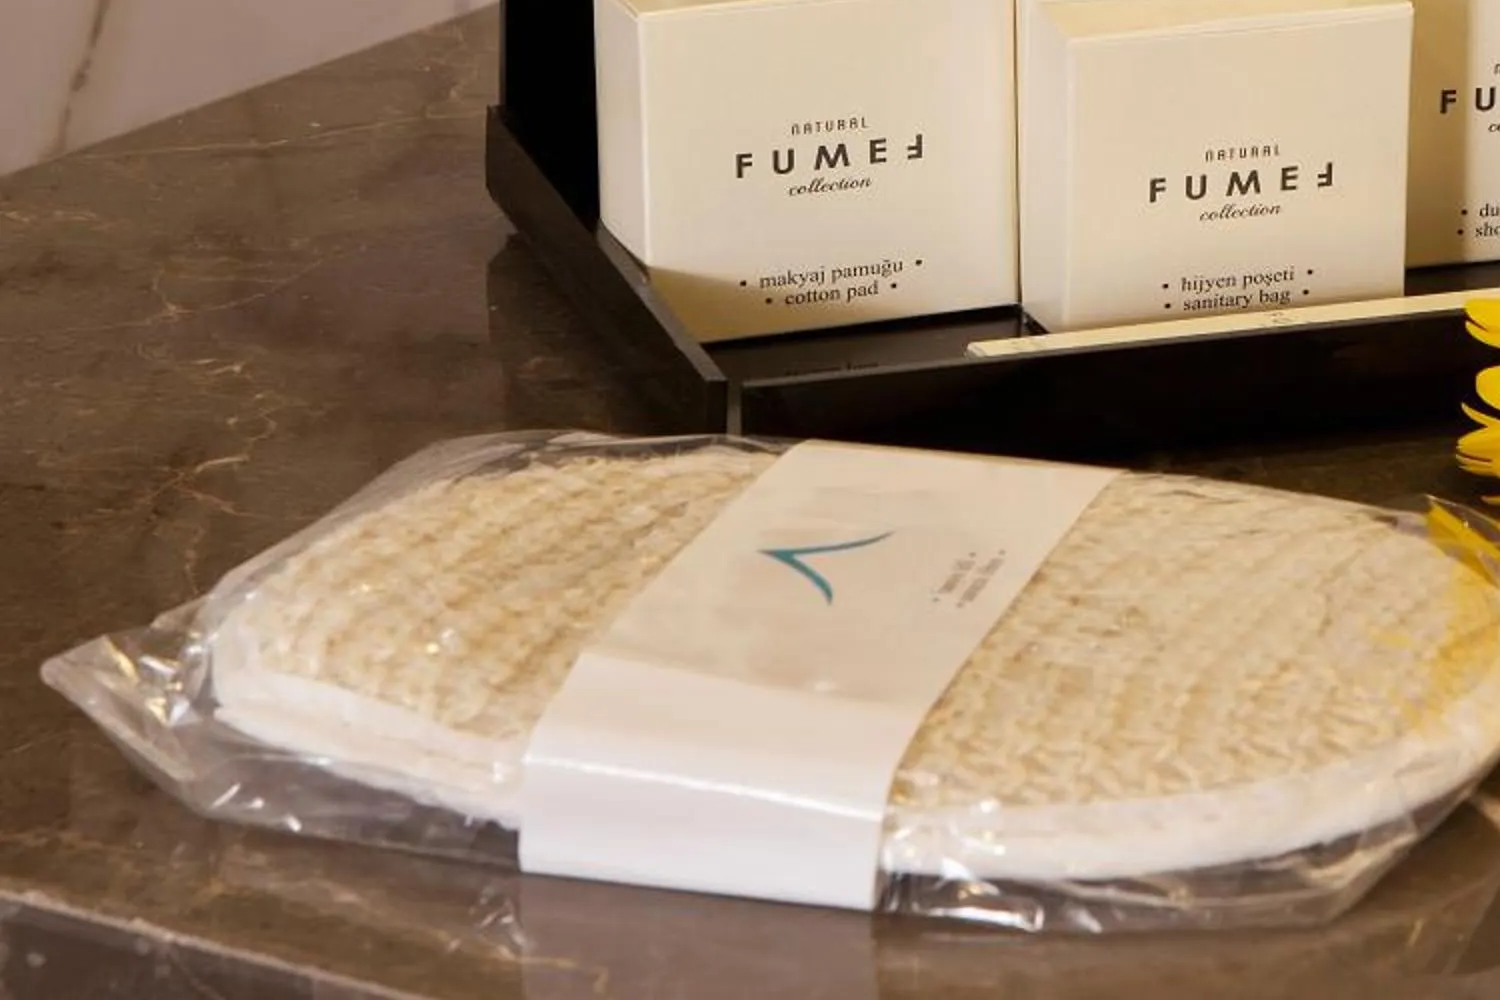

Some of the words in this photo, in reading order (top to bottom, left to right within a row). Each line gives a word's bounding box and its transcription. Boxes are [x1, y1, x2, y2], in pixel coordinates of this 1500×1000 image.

[789, 176, 872, 196] collection
[1199, 203, 1281, 221] collection
[759, 268, 825, 289] makyaj
[831, 260, 904, 284] pamuğu
[1181, 273, 1237, 294] hijyen
[1243, 265, 1295, 289] poşeti
[785, 287, 841, 305] cotton
[847, 280, 879, 302] pad
[1183, 293, 1252, 311] sanitary
[1259, 289, 1291, 305] bag
